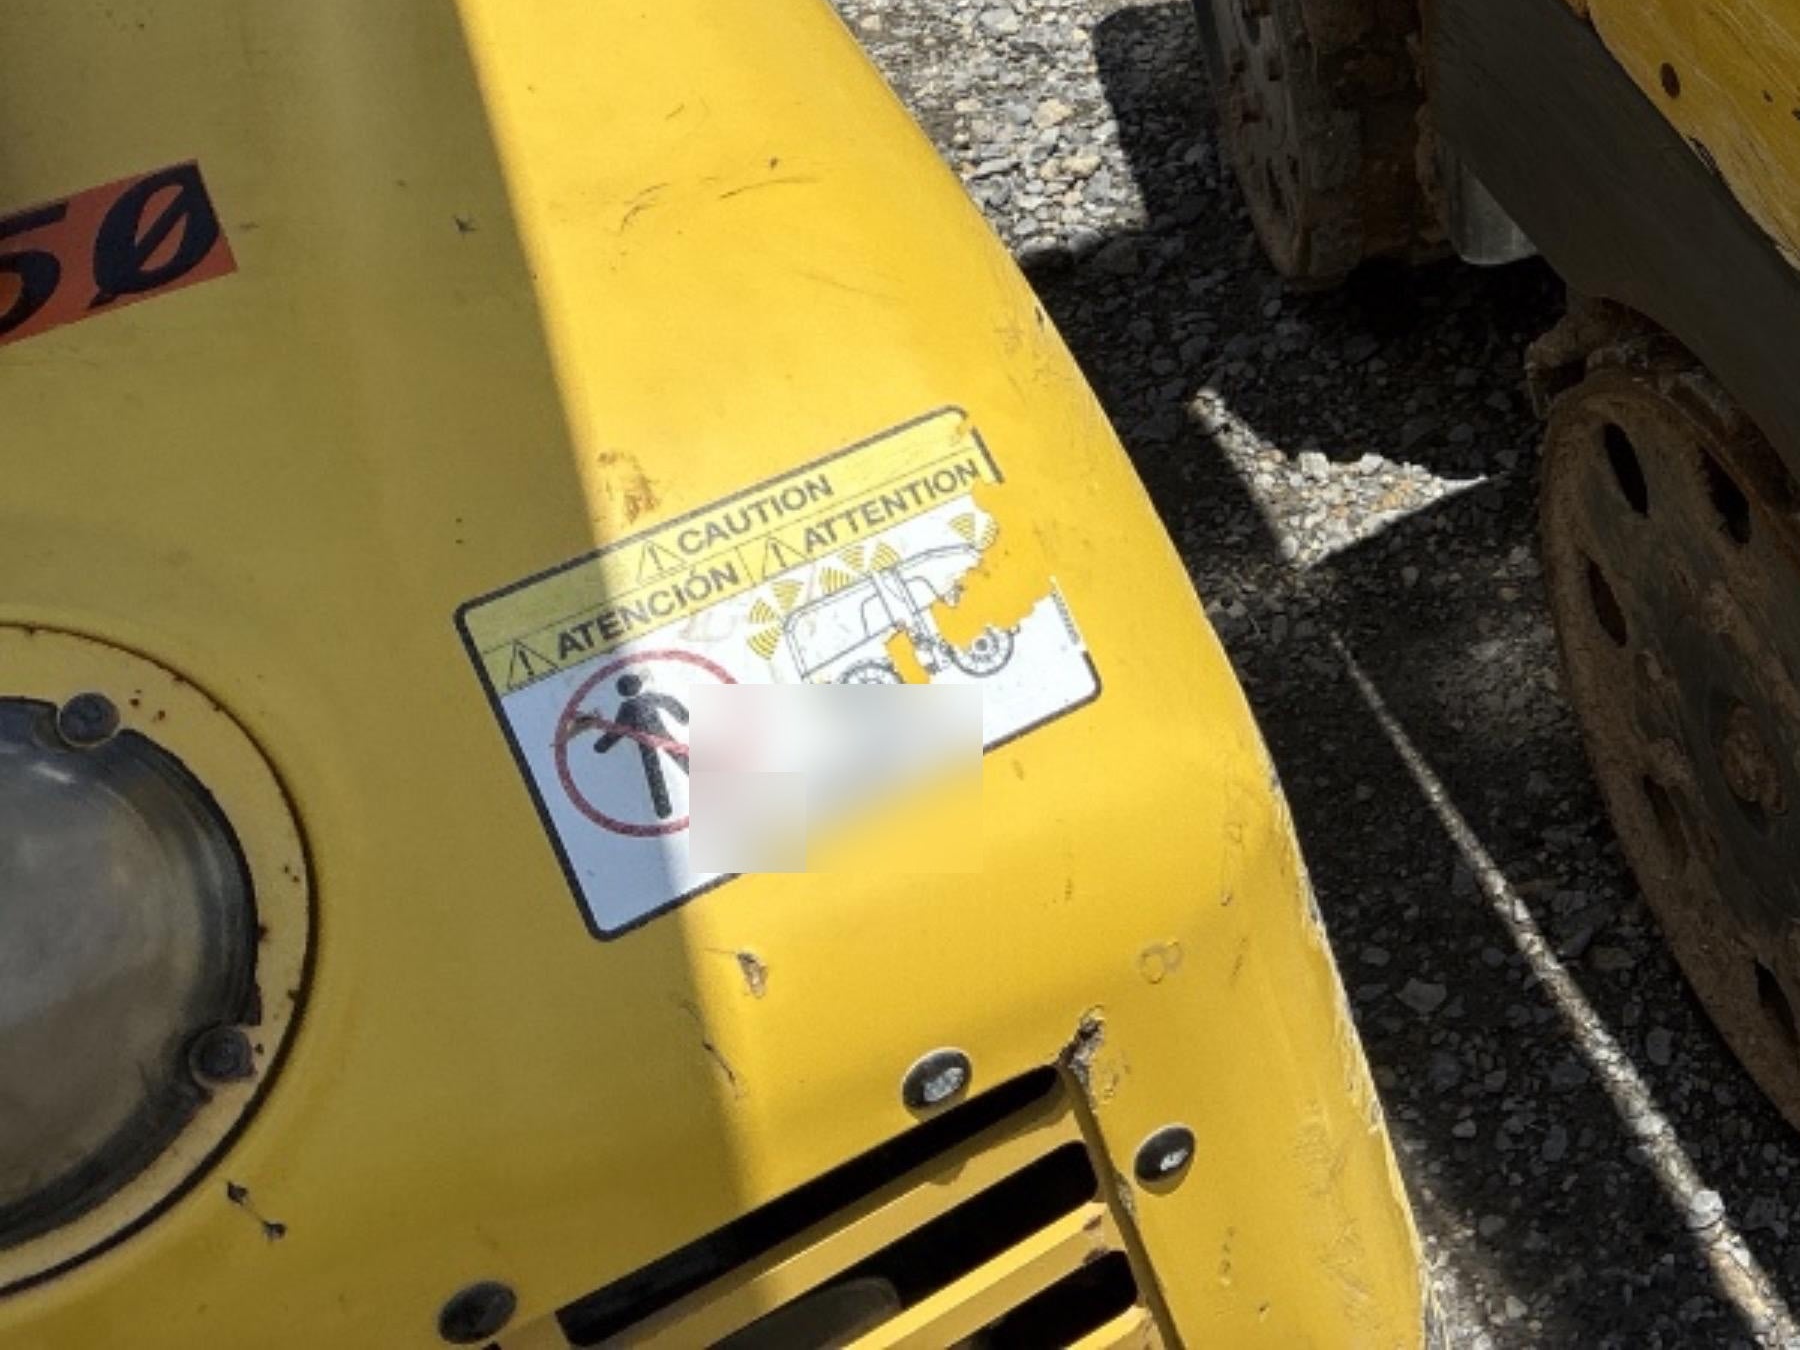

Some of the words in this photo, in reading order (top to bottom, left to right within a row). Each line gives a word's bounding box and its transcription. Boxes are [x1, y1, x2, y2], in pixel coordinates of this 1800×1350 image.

[556, 561, 742, 660] ATENCIÓN
[802, 457, 979, 554] ATTENTION
[675, 473, 837, 556] CAUTION
